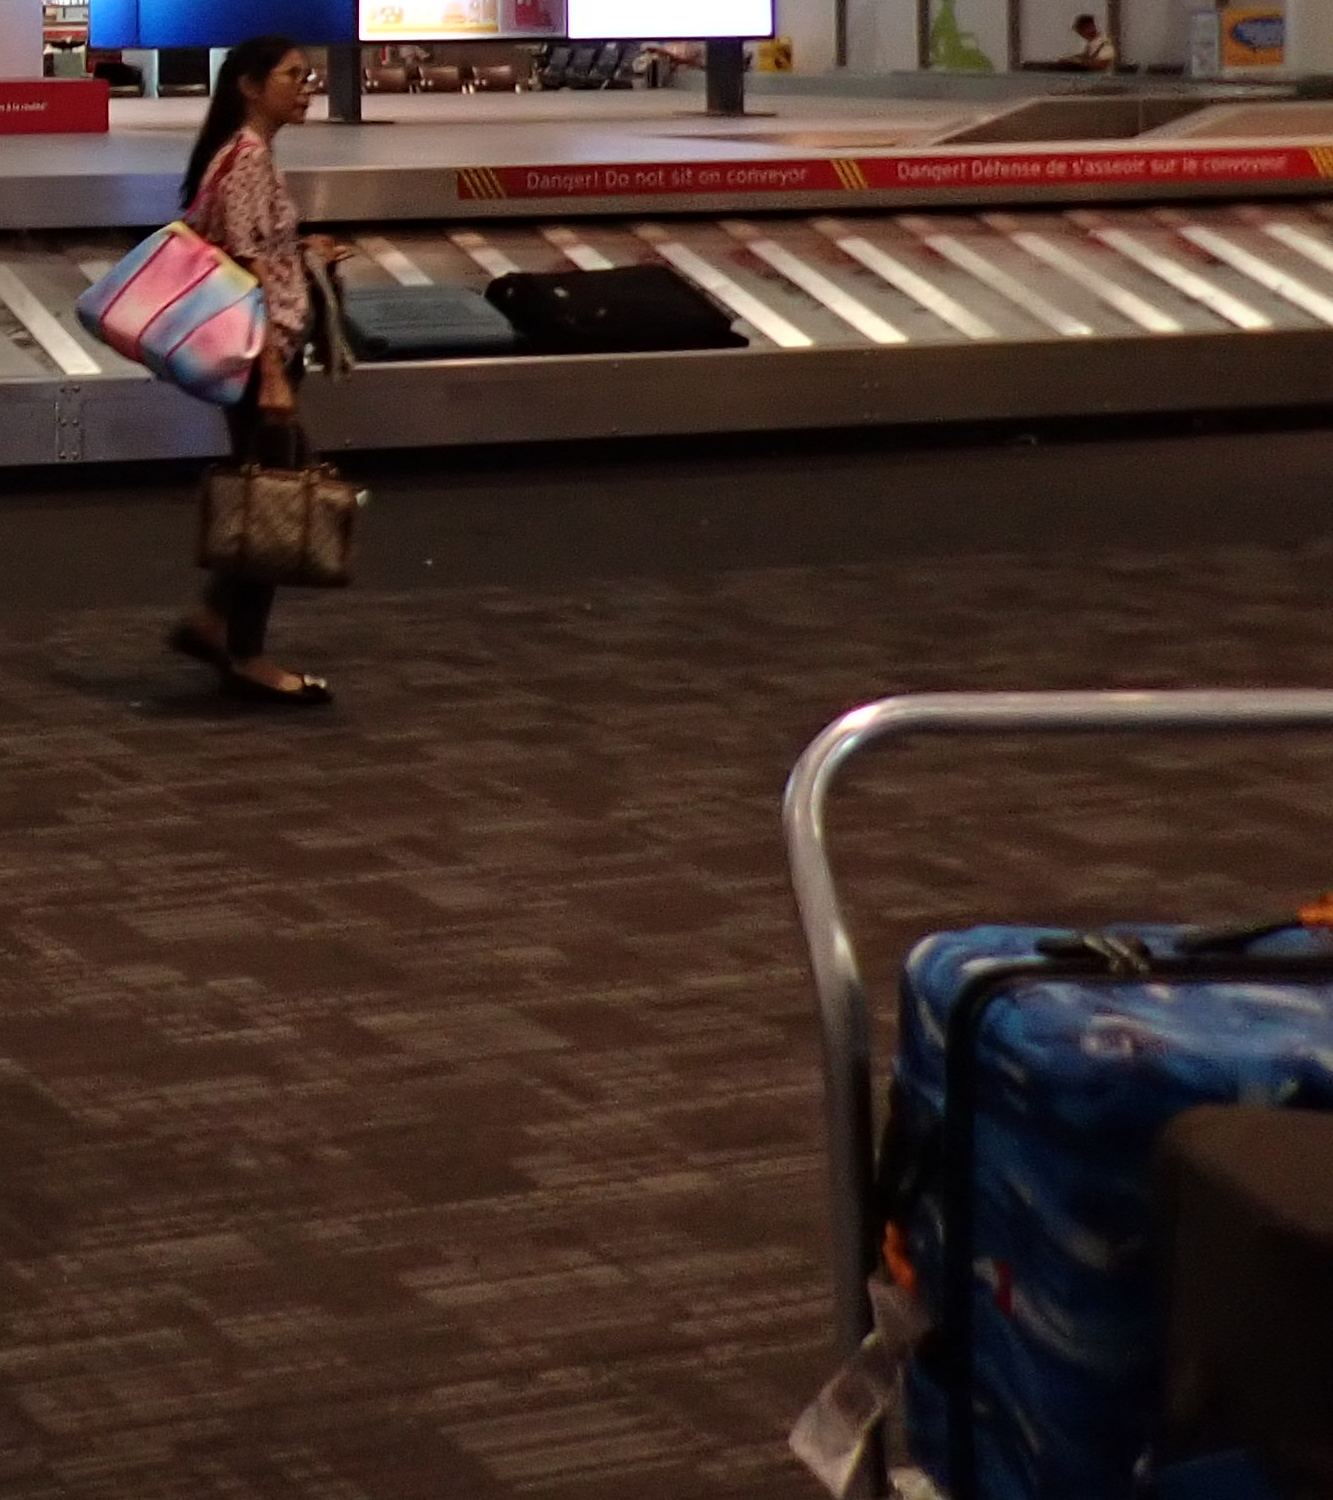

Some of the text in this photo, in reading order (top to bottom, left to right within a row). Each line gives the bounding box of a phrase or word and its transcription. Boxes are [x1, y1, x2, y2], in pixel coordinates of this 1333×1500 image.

[526, 167, 807, 191] Danger! Do not sit on conveyor
[896, 161, 966, 181] Danger!
[971, 158, 1041, 177] Défense
[1045, 159, 1068, 175] de
[1151, 158, 1176, 172] sur
[1183, 156, 1198, 171] le
